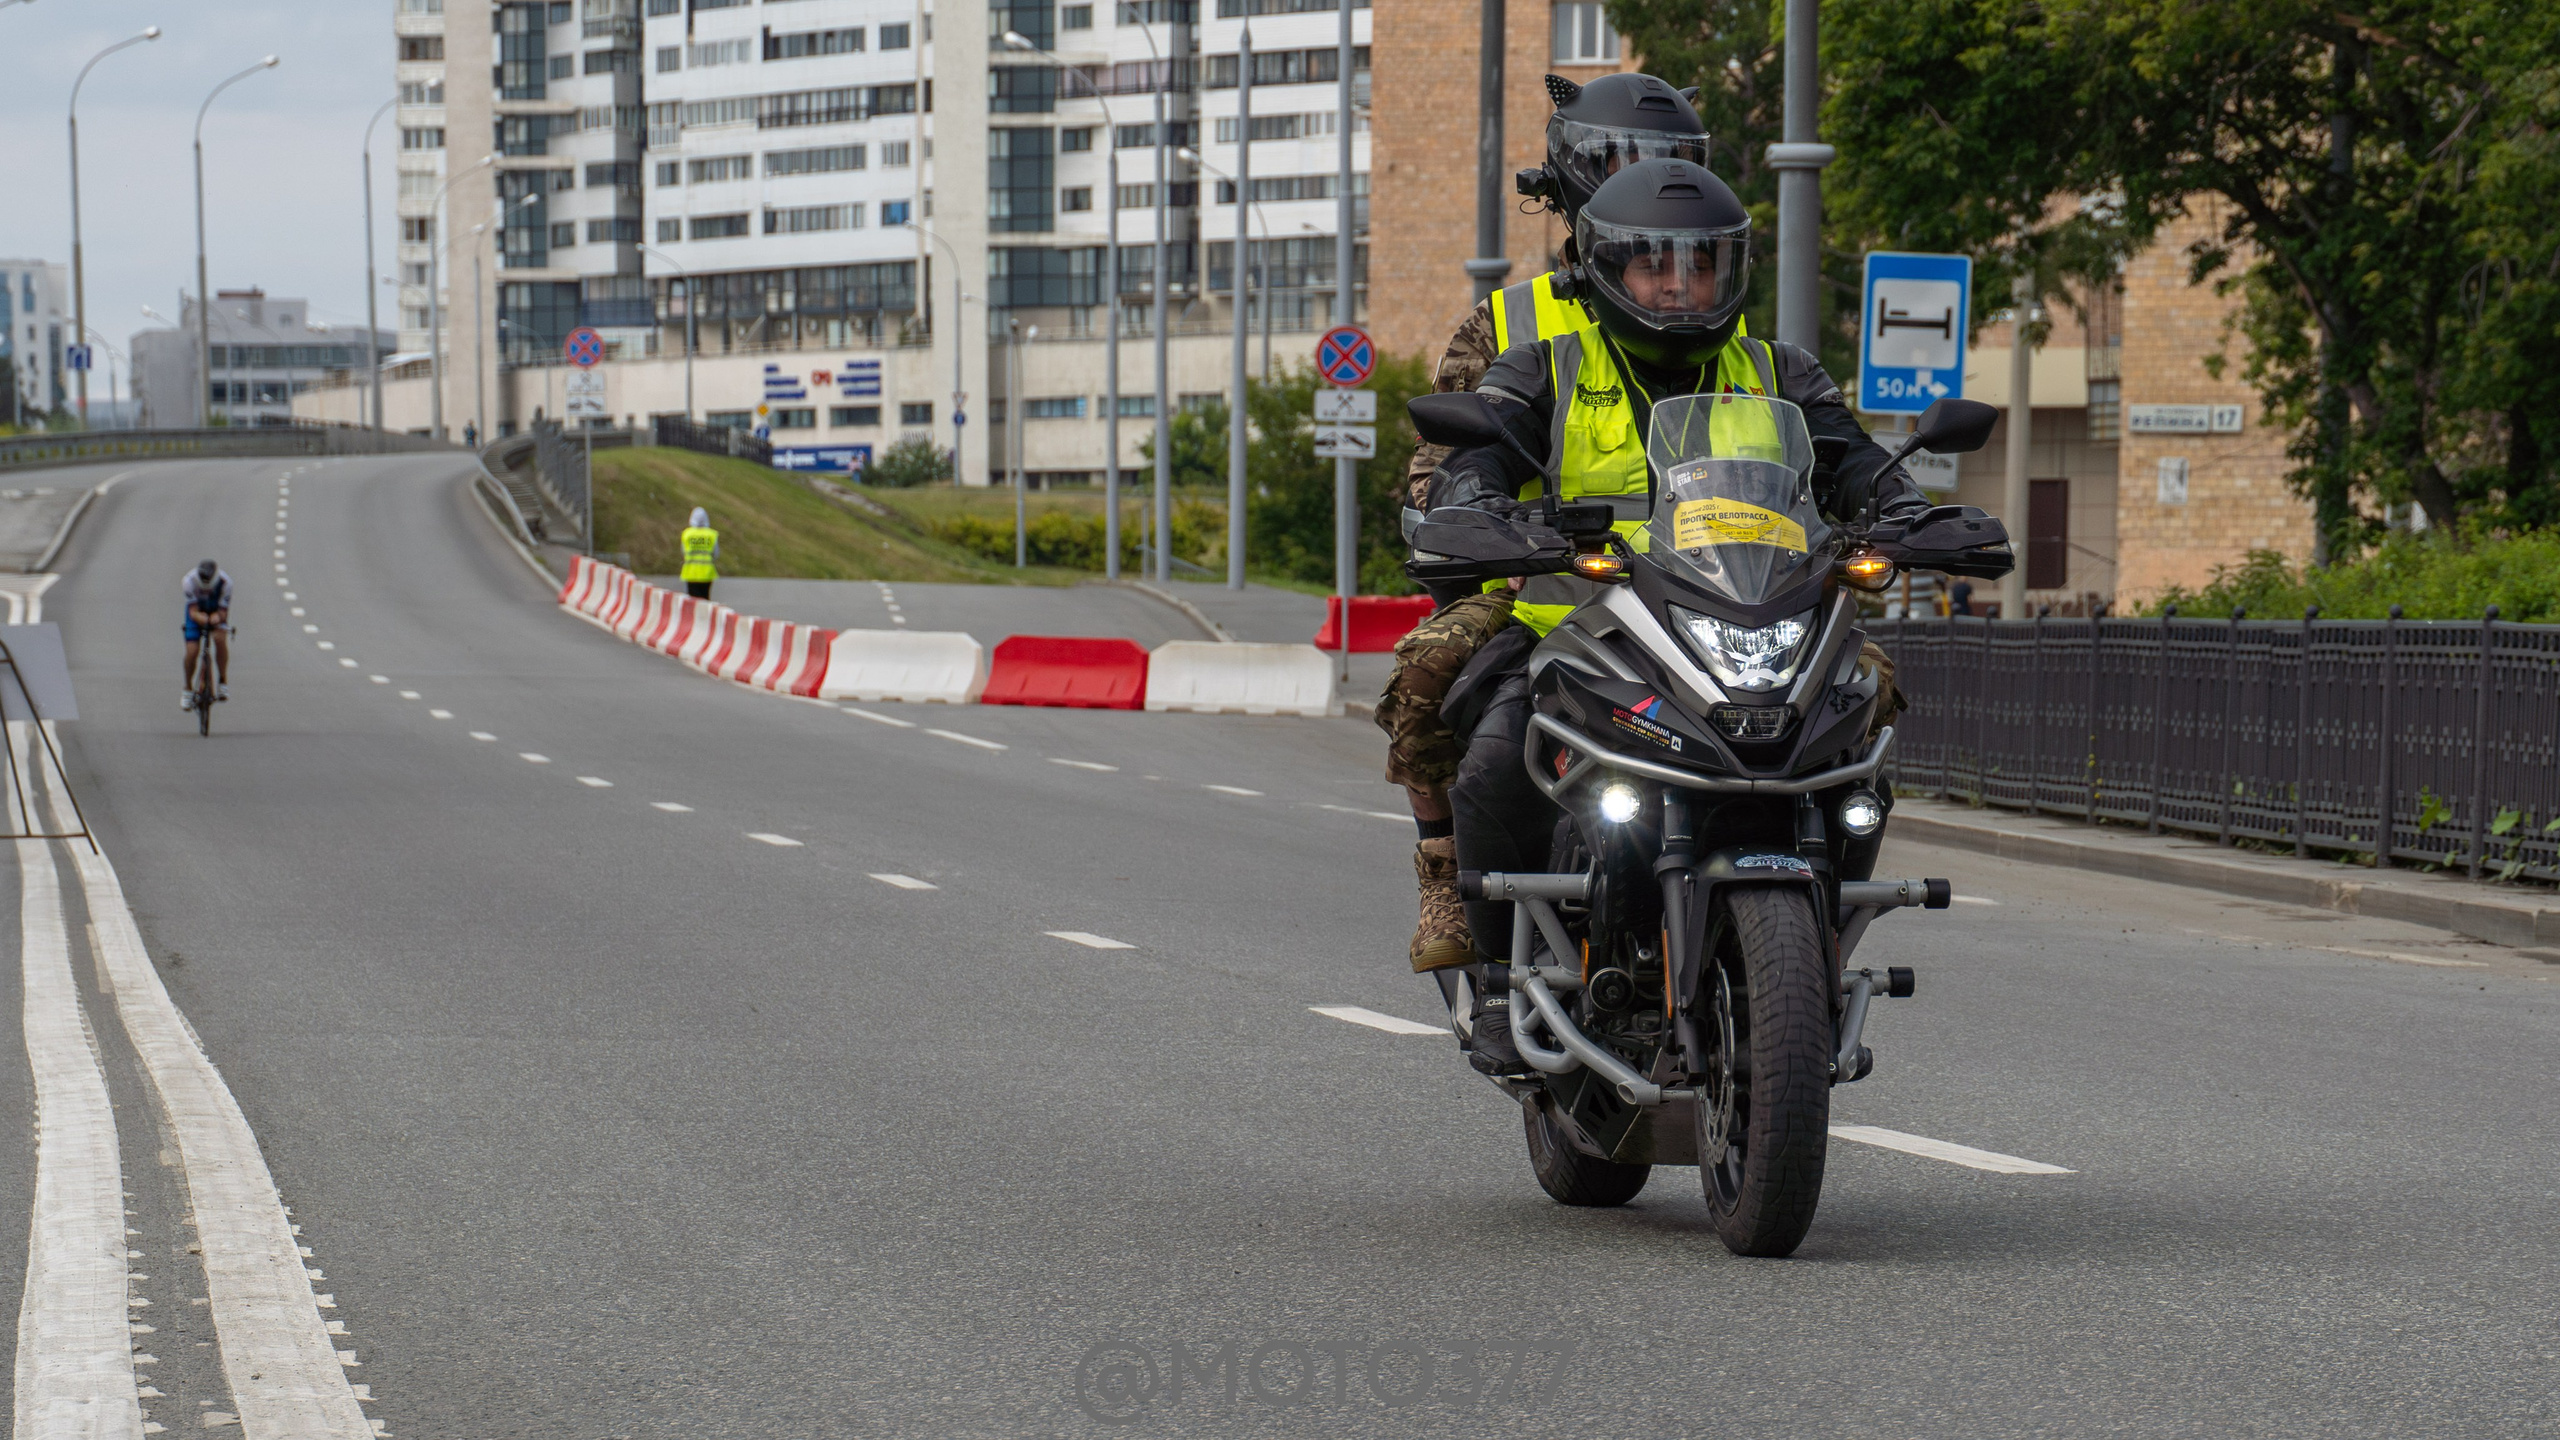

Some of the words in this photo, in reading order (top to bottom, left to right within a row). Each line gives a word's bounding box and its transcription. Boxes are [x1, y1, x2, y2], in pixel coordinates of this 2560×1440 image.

[2216, 408, 2237, 427] 17
[1702, 503, 1716, 512] 2025
[1680, 512, 1717, 526] ПРОПУСК
[1718, 511, 1770, 521] ВЕЛОТРАССА
[1636, 726, 1647, 735] CUP
